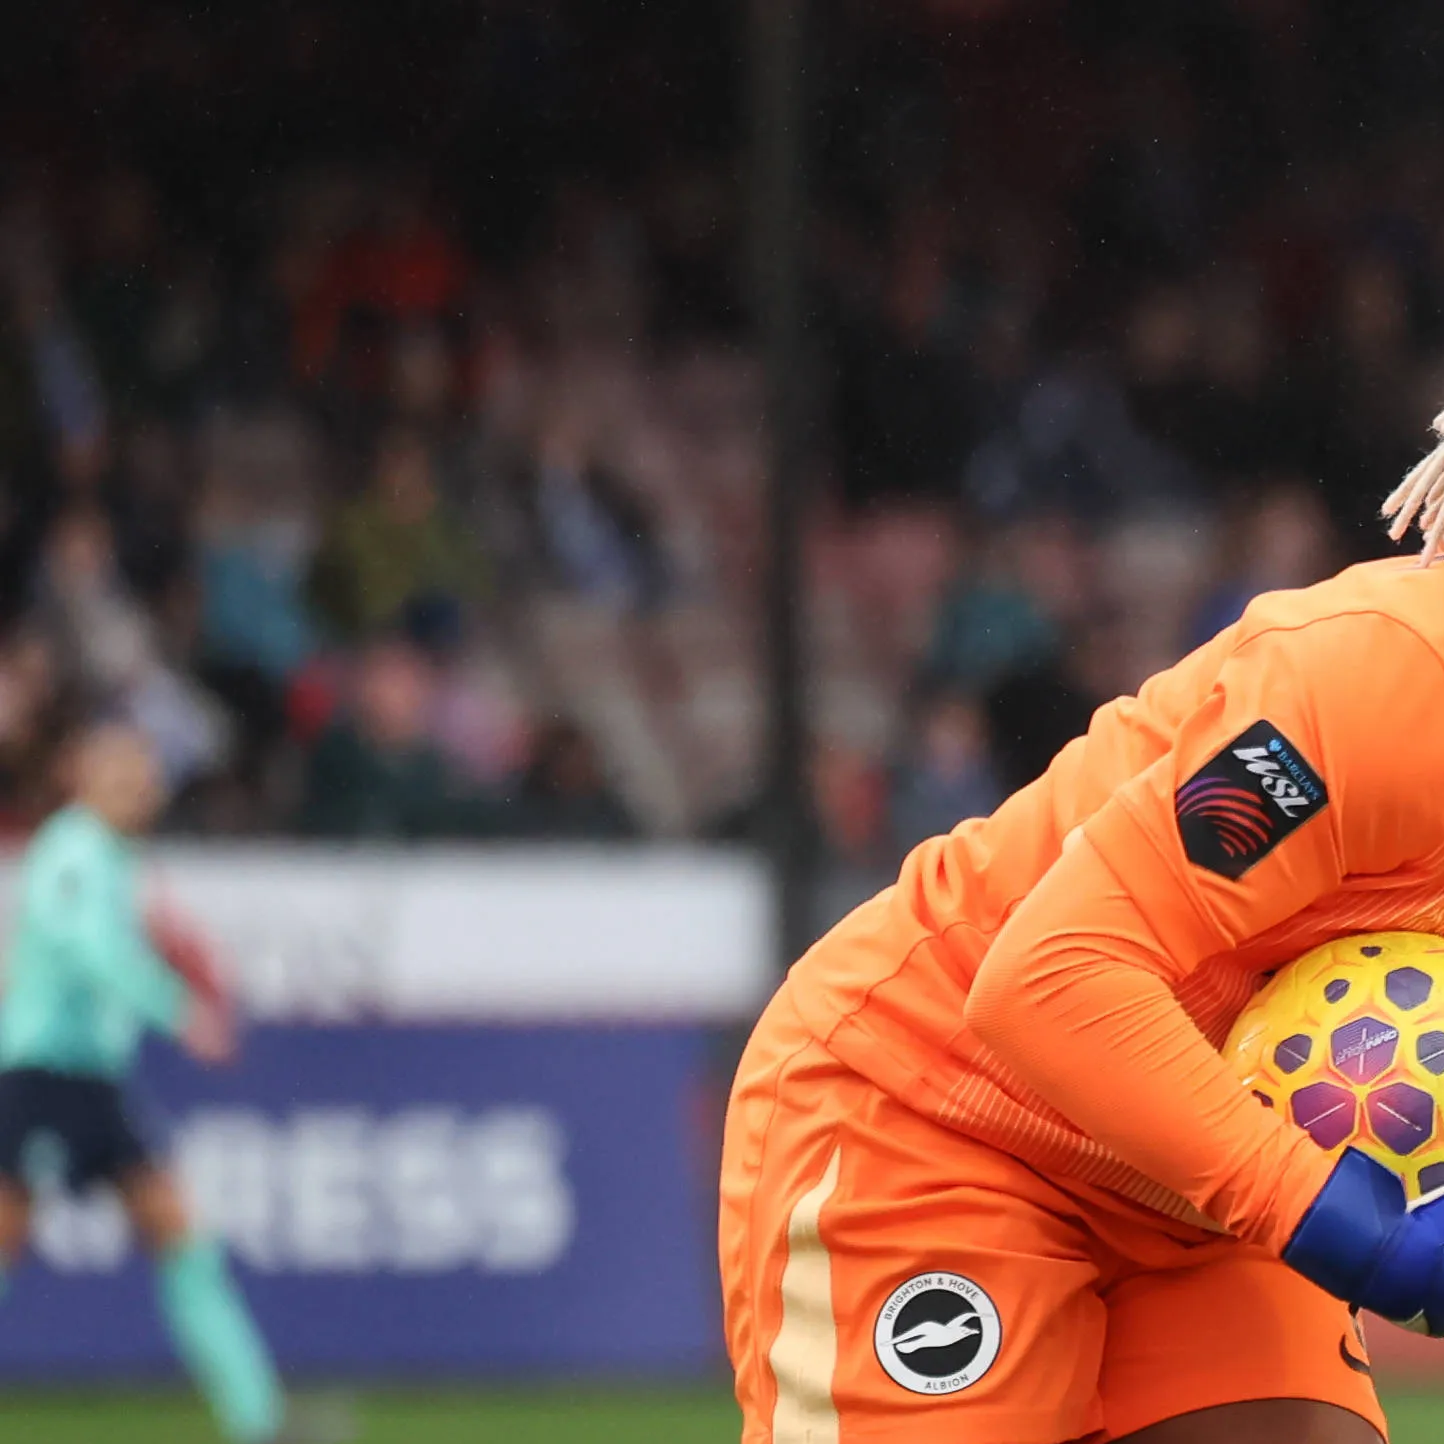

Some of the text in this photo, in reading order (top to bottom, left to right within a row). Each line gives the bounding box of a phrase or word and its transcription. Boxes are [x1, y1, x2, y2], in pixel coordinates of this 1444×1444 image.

[1232, 747, 1309, 817] WSL
[1278, 751, 1320, 800] BARCLAYS
[884, 1277, 932, 1320] BRIGHTON
[948, 1279, 980, 1300] HOVE
[924, 1373, 969, 1391] ALBION
